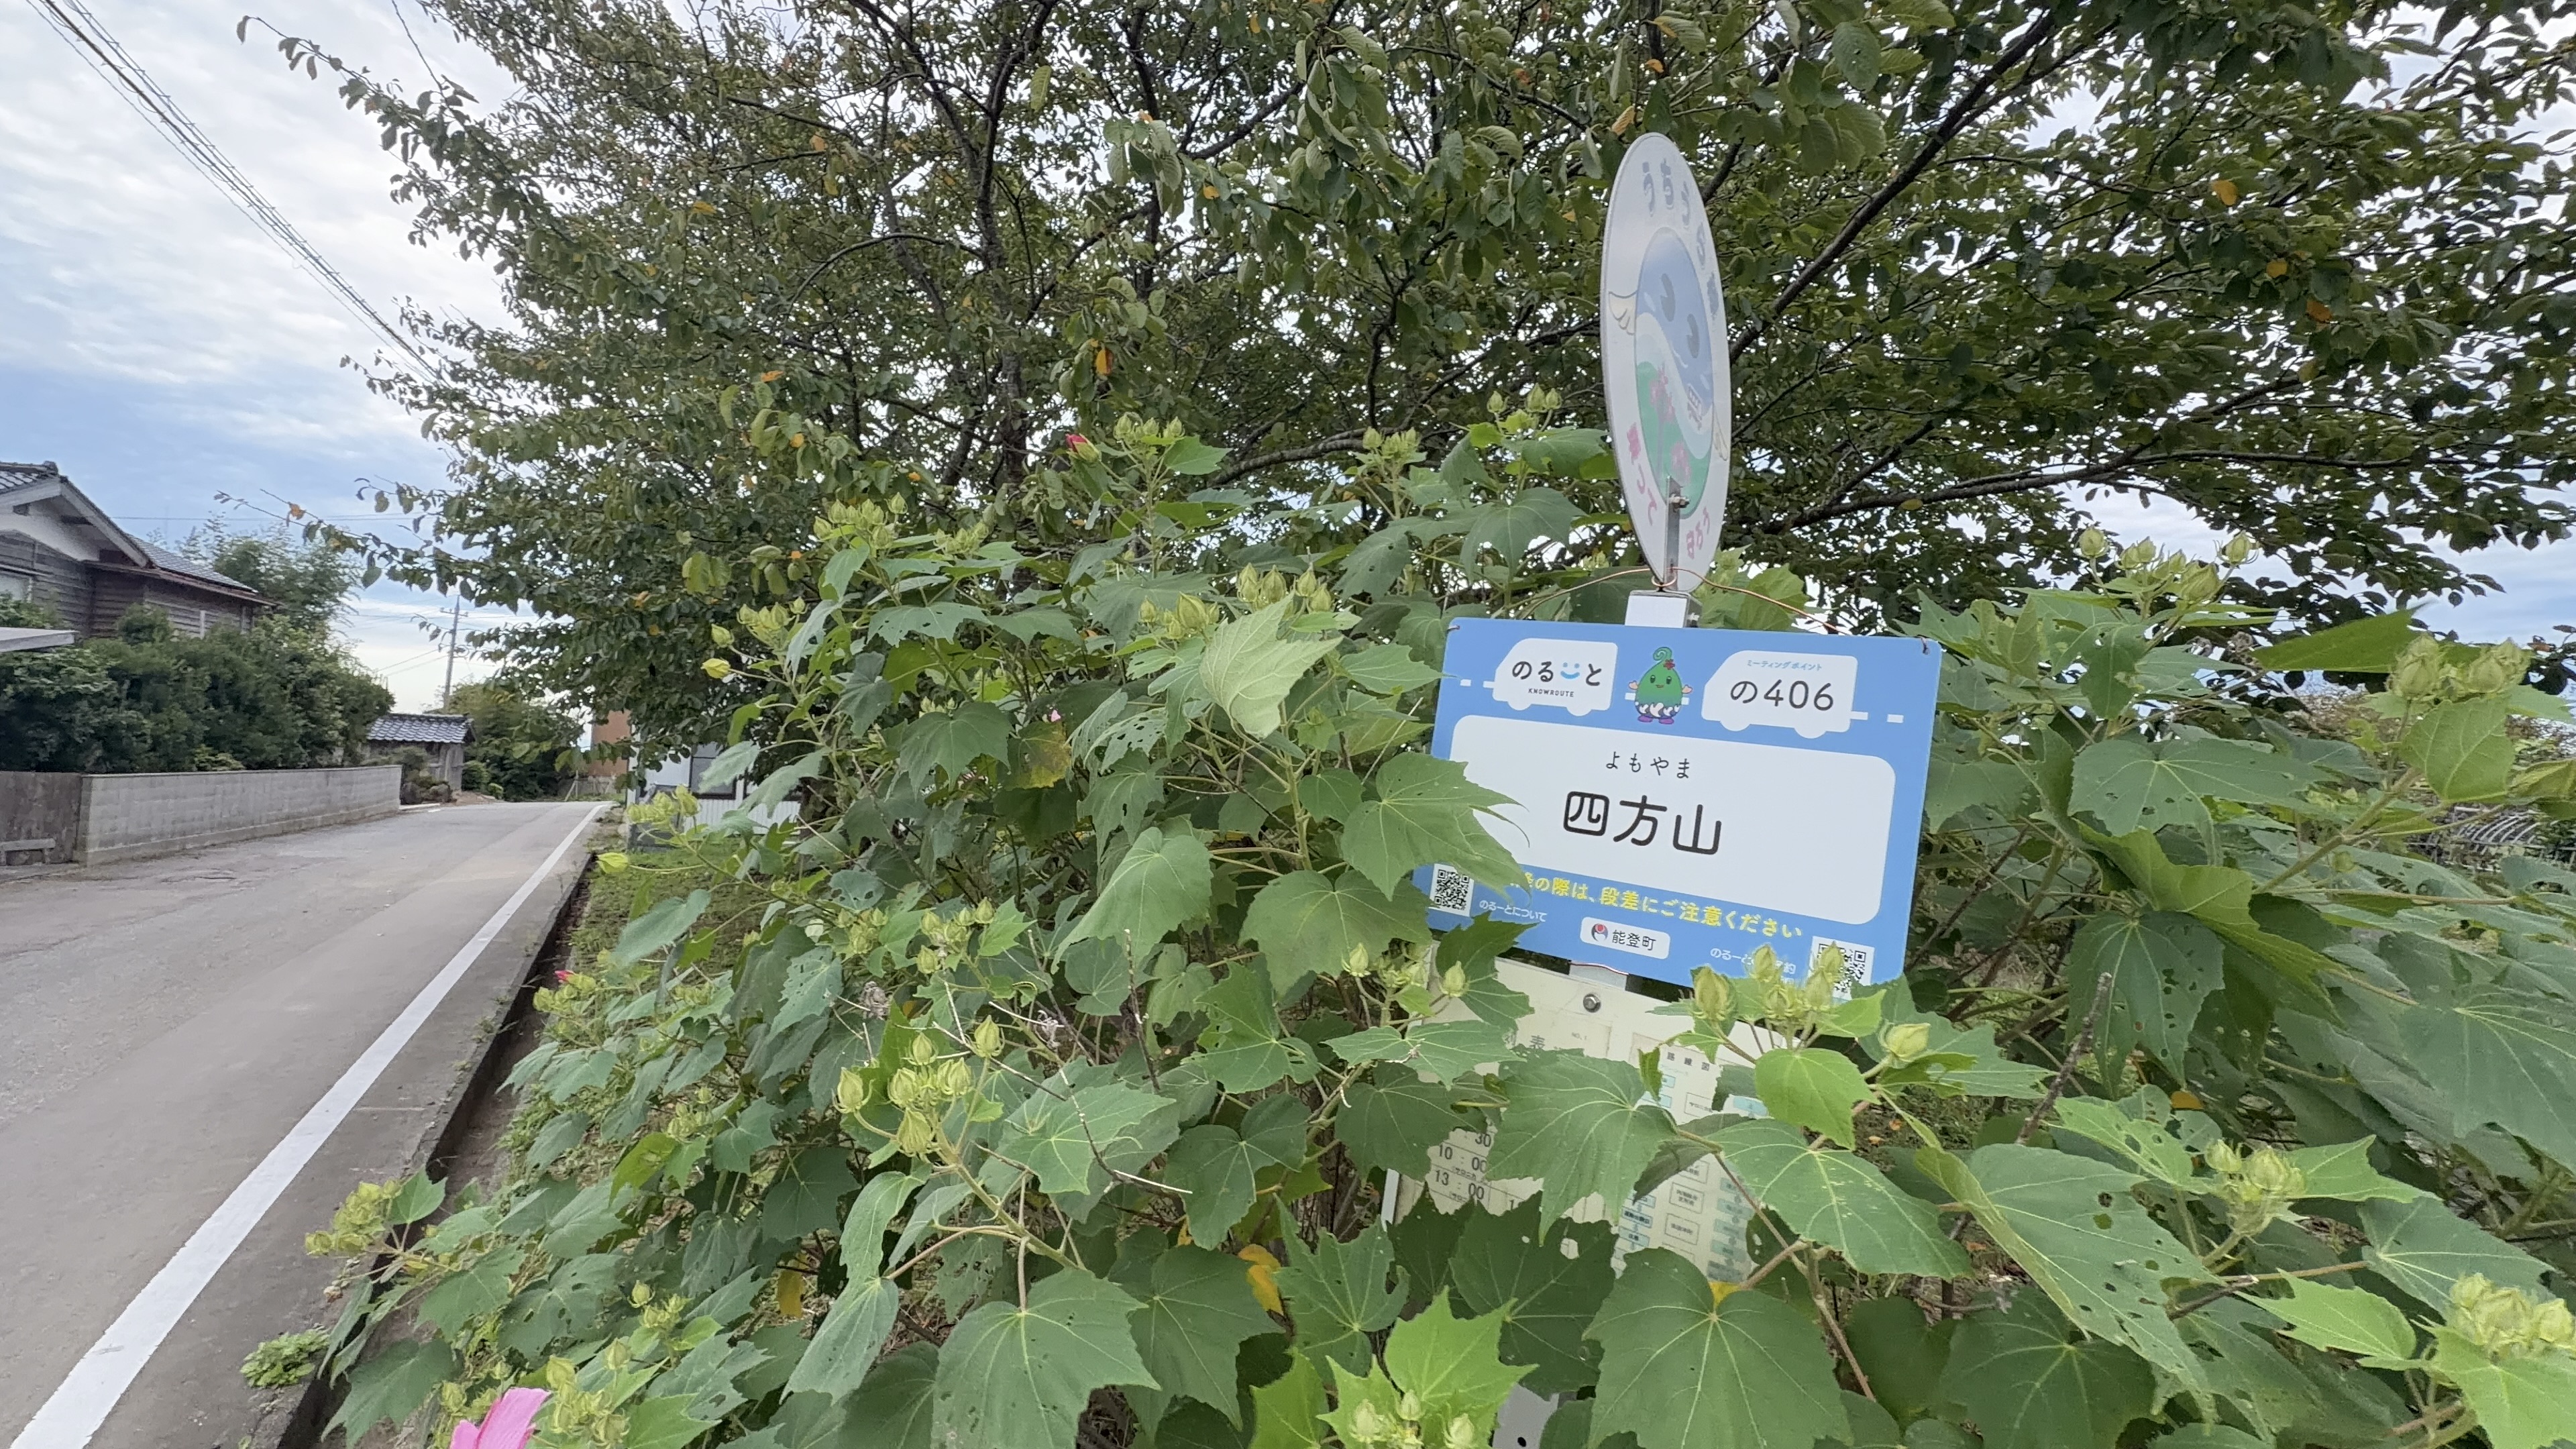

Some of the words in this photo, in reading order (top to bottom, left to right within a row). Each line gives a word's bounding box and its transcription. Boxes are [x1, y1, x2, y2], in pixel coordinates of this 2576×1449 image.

[1528, 688, 1574, 698] KNOWROUTE
[1729, 679, 1834, 712] の406
[1605, 751, 1690, 779] よもやま
[1563, 790, 1722, 855] 四方山
[1479, 900, 1548, 923] のるーとについて
[1611, 929, 1657, 952] 能登町
[1474, 1132, 1492, 1147] 30
[1438, 1144, 1454, 1161] 10
[1434, 1169, 1450, 1186] 13
